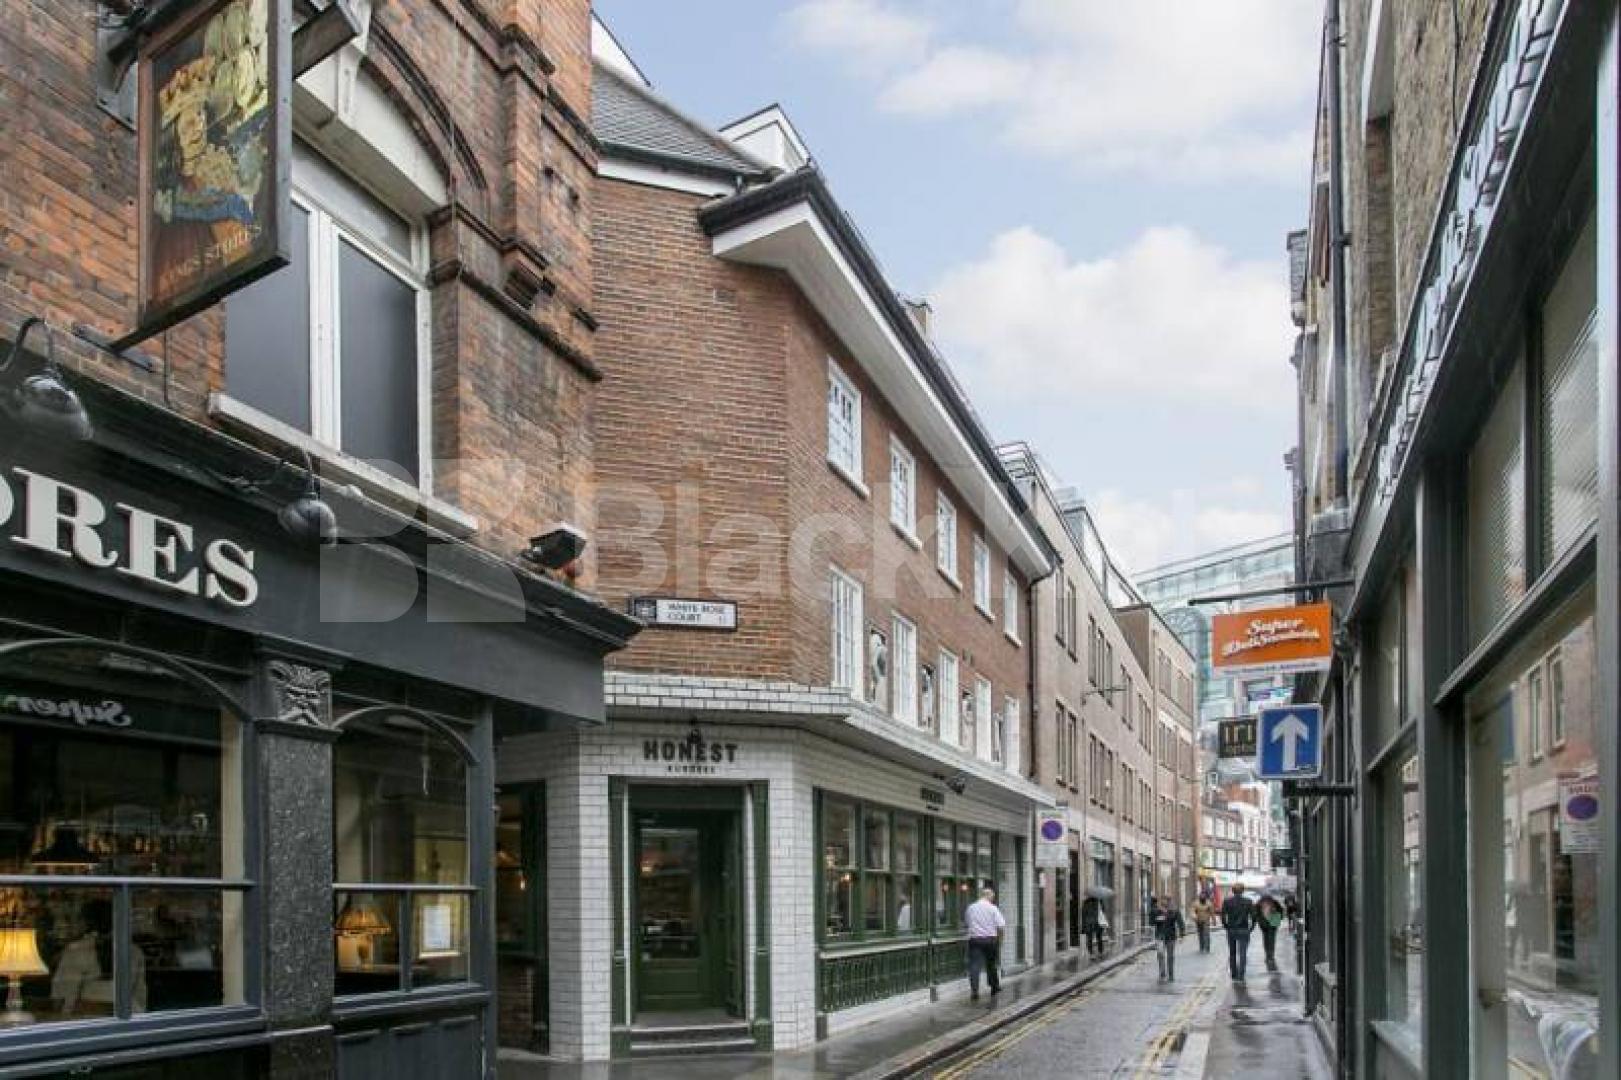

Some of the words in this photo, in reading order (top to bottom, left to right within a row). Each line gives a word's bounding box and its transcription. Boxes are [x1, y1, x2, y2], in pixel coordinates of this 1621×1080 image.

[0, 466, 258, 606] RES
[667, 602, 698, 613] WHITE
[667, 612, 701, 622] COURT
[643, 740, 738, 763] HONEST
